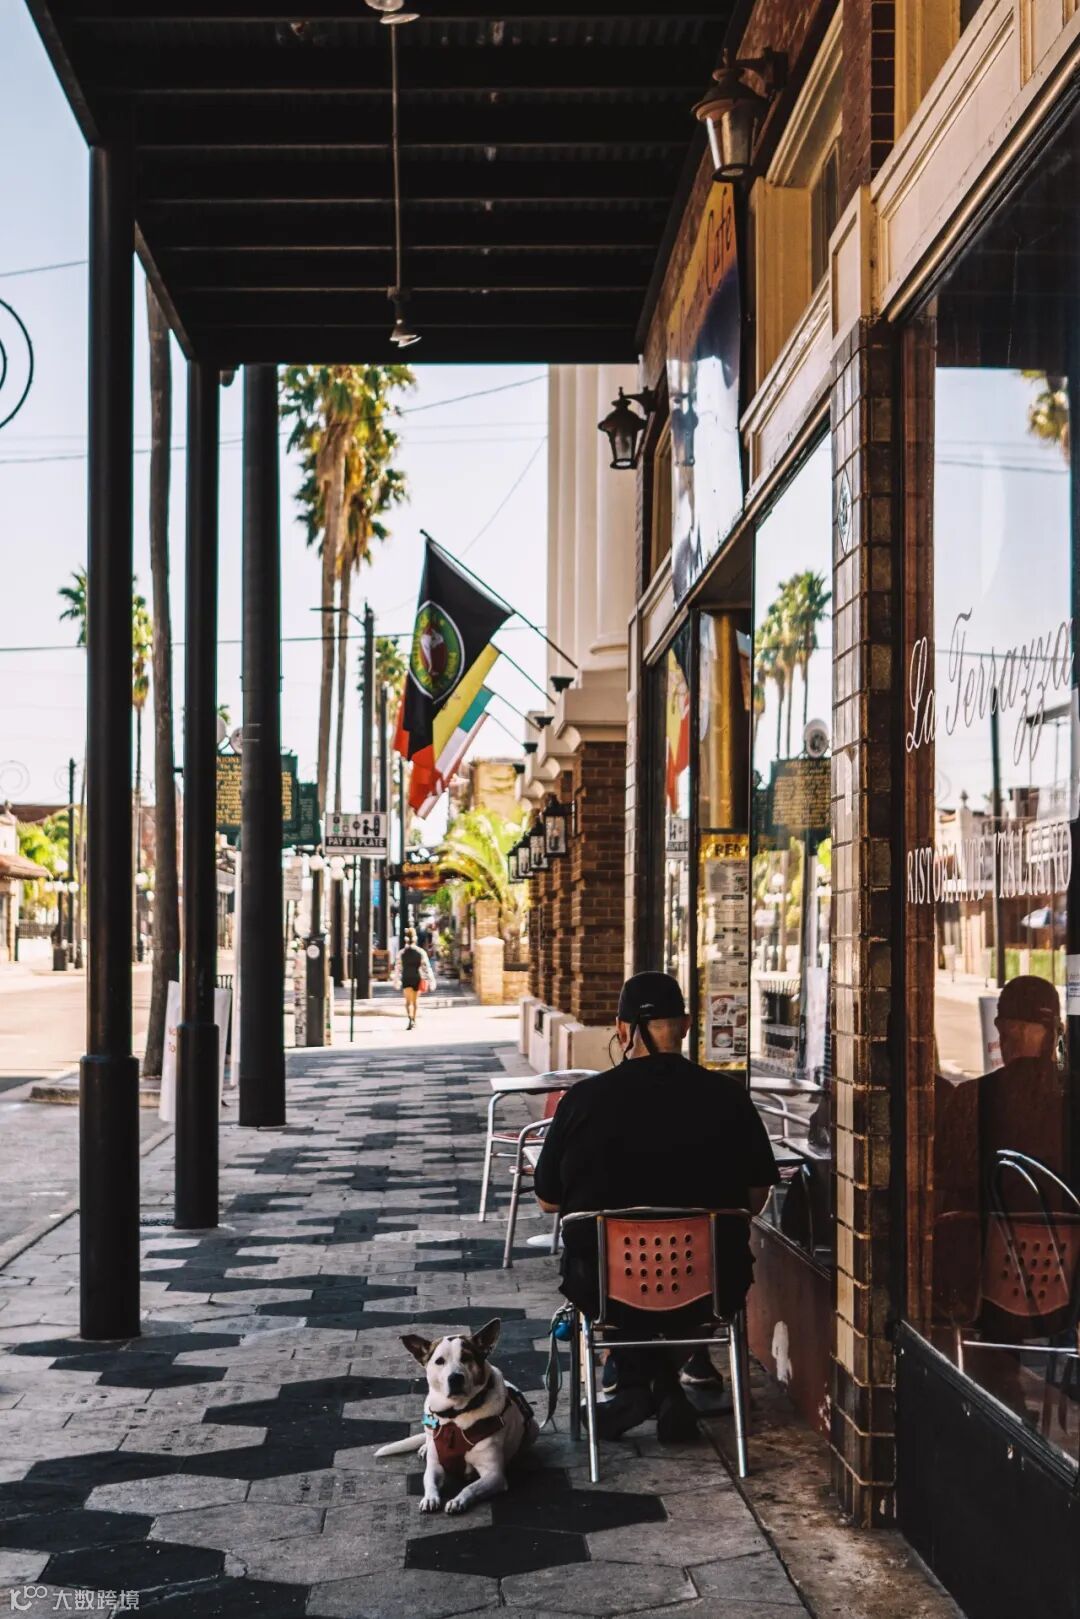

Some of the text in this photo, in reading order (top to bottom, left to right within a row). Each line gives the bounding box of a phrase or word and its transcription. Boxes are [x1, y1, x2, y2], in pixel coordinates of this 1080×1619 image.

[906, 607, 1074, 766] La Terrazza
[328, 838, 384, 846] PAY BY PLATE
[907, 822, 1073, 905] RISTORANTE ITALIANO
